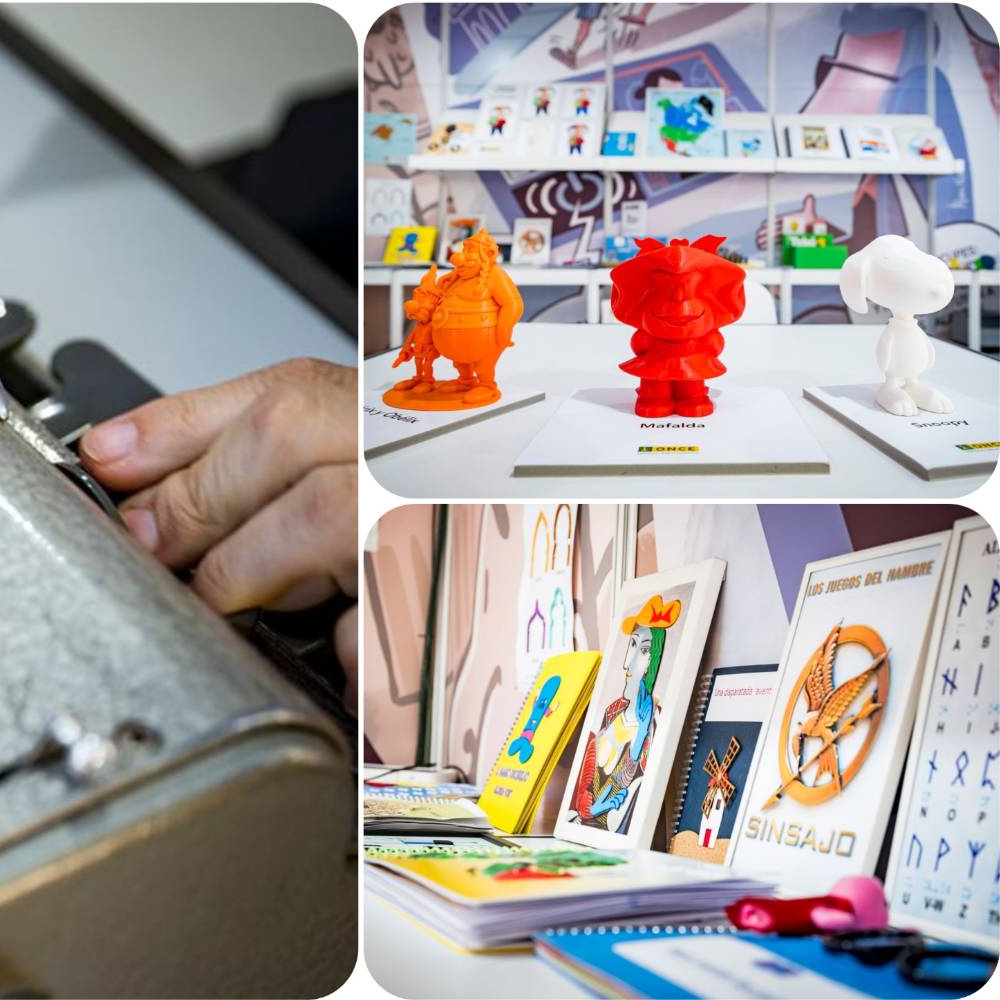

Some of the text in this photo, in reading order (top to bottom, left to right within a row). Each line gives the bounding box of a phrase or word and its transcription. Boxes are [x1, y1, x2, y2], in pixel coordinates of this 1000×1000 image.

[911, 420, 969, 428] Snoopy
[807, 560, 935, 597] LOS JUEGOS DEL HAMBRE
[744, 815, 857, 858] SINSAJO
